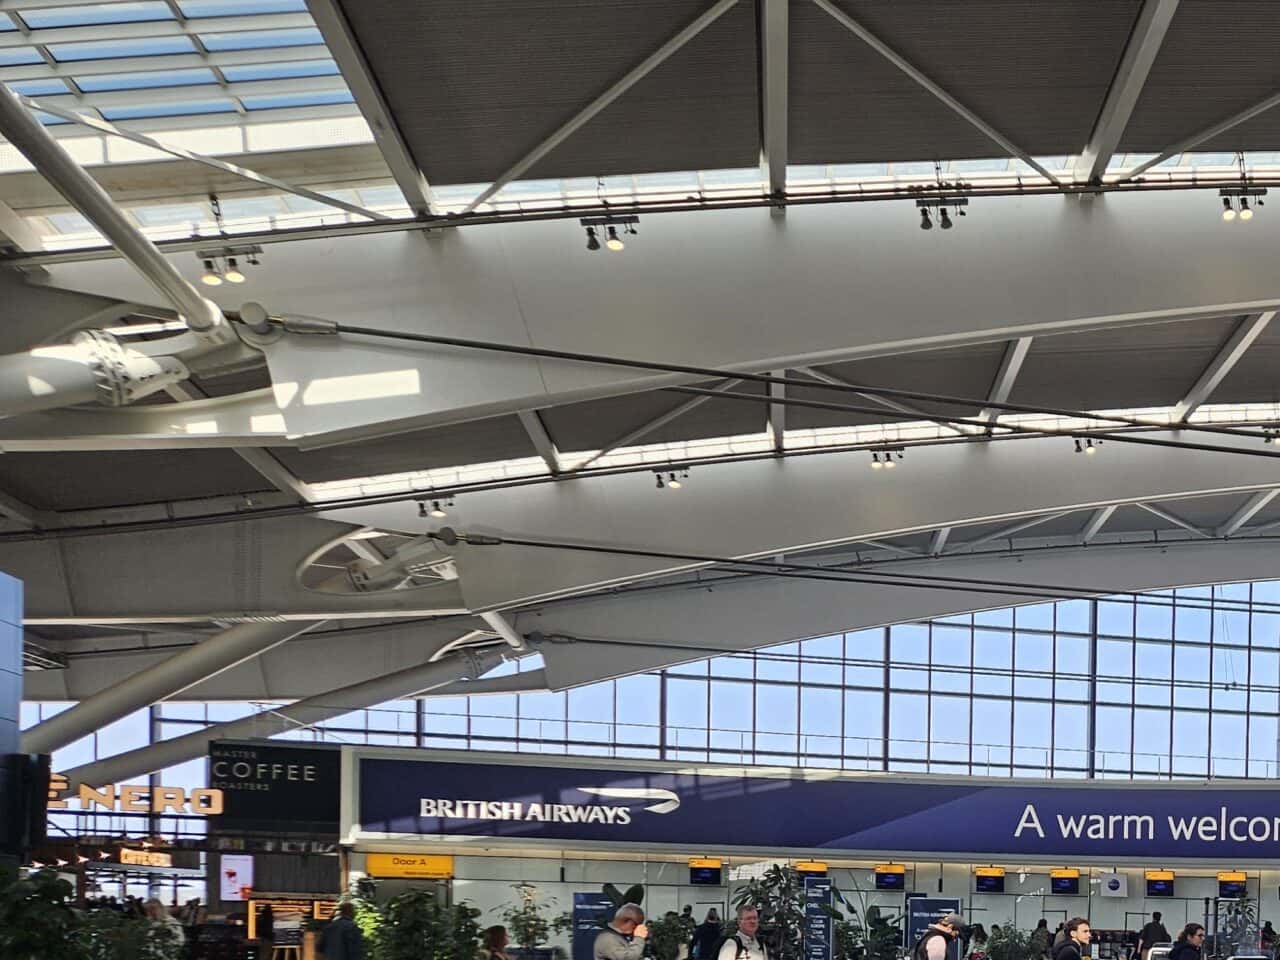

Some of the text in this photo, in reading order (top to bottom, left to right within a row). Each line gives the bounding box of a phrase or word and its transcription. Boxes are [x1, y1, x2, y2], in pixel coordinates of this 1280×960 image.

[213, 761, 317, 782] COFFEE
[79, 783, 225, 815] NERO
[420, 798, 632, 825] BRITISH AIRWAYS
[1014, 804, 1045, 838] A
[1057, 814, 1155, 840] warm
